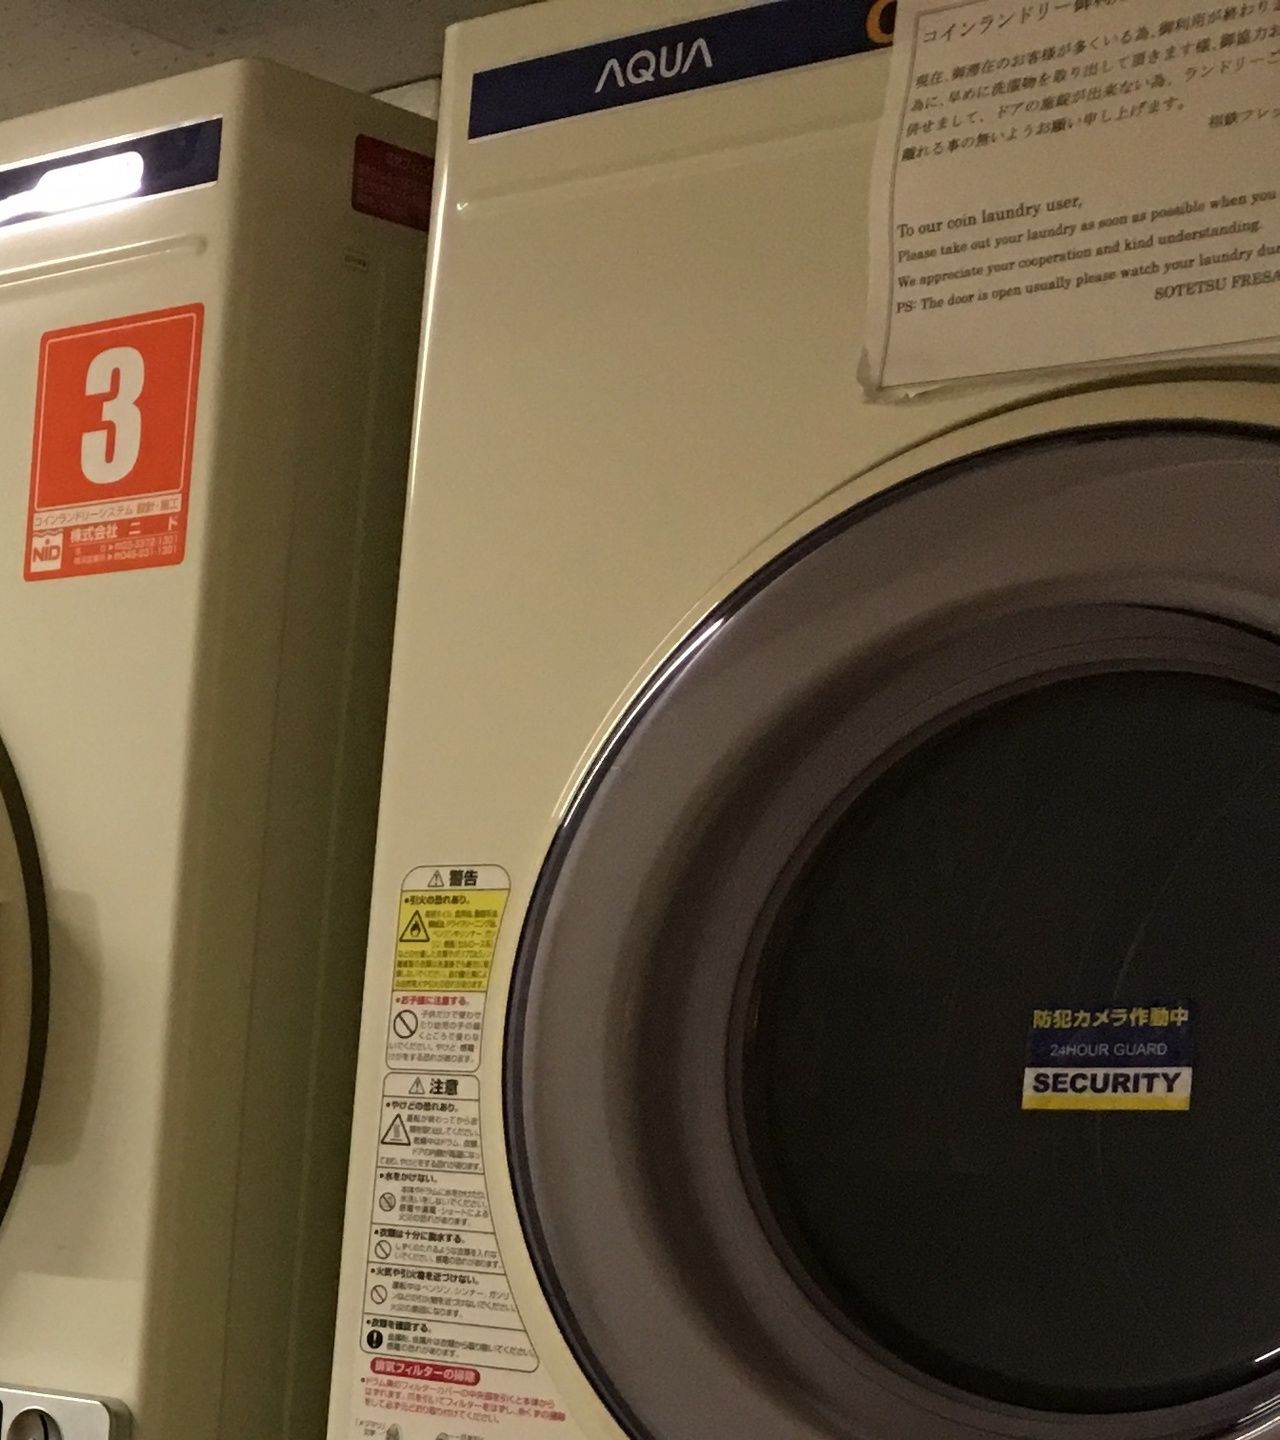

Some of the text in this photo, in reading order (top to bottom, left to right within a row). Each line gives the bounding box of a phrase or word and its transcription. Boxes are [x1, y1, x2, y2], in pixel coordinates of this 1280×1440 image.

[595, 38, 712, 93] AQUA
[897, 196, 1083, 238] To our coin laundry user,
[897, 189, 1277, 263] Please take out your laundry as soon as possible when you
[897, 275, 916, 289] We
[919, 265, 984, 287] appreciate
[987, 260, 1017, 276] your
[1018, 246, 1092, 268] cooperation
[1096, 240, 1120, 256] and
[1124, 235, 1154, 251] kind
[920, 296, 945, 311] The
[948, 291, 975, 306] door
[977, 288, 989, 301] is
[992, 285, 1022, 300] open
[1026, 275, 1072, 294] usually
[1076, 269, 1117, 288] please
[1120, 261, 1160, 279] watch
[1163, 257, 1195, 275] your
[1199, 248, 1254, 267] laundry
[1154, 277, 1228, 300] SOTETSU
[80, 346, 142, 485] 3
[70, 524, 118, 543] 株式会社
[449, 870, 478, 887] 警告
[1032, 1006, 1189, 1029] 防犯カメラ作動中
[1050, 1042, 1168, 1057] 24HOUR GUARD
[429, 1078, 459, 1096] 注意
[1032, 1072, 1181, 1094] SECURITY
